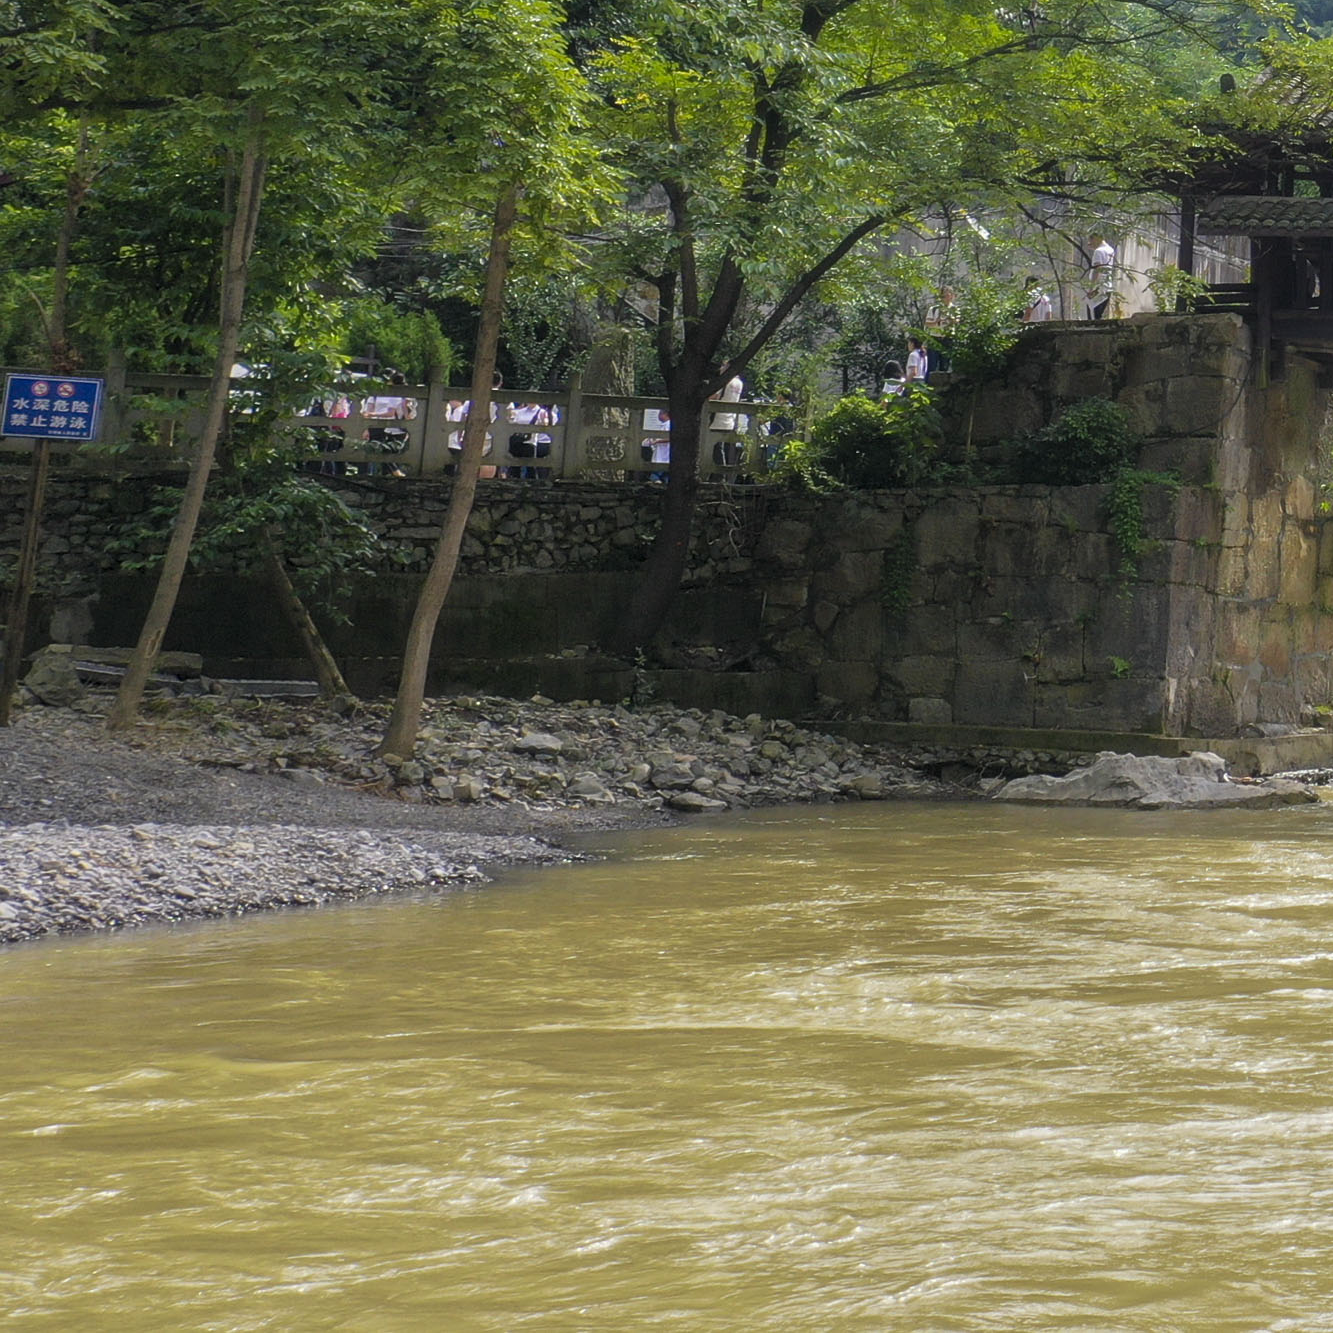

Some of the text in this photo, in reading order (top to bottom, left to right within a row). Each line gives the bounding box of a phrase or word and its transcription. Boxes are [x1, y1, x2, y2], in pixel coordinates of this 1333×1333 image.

[12, 397, 90, 414] 水深危险
[10, 413, 87, 429] 禁止游泳
